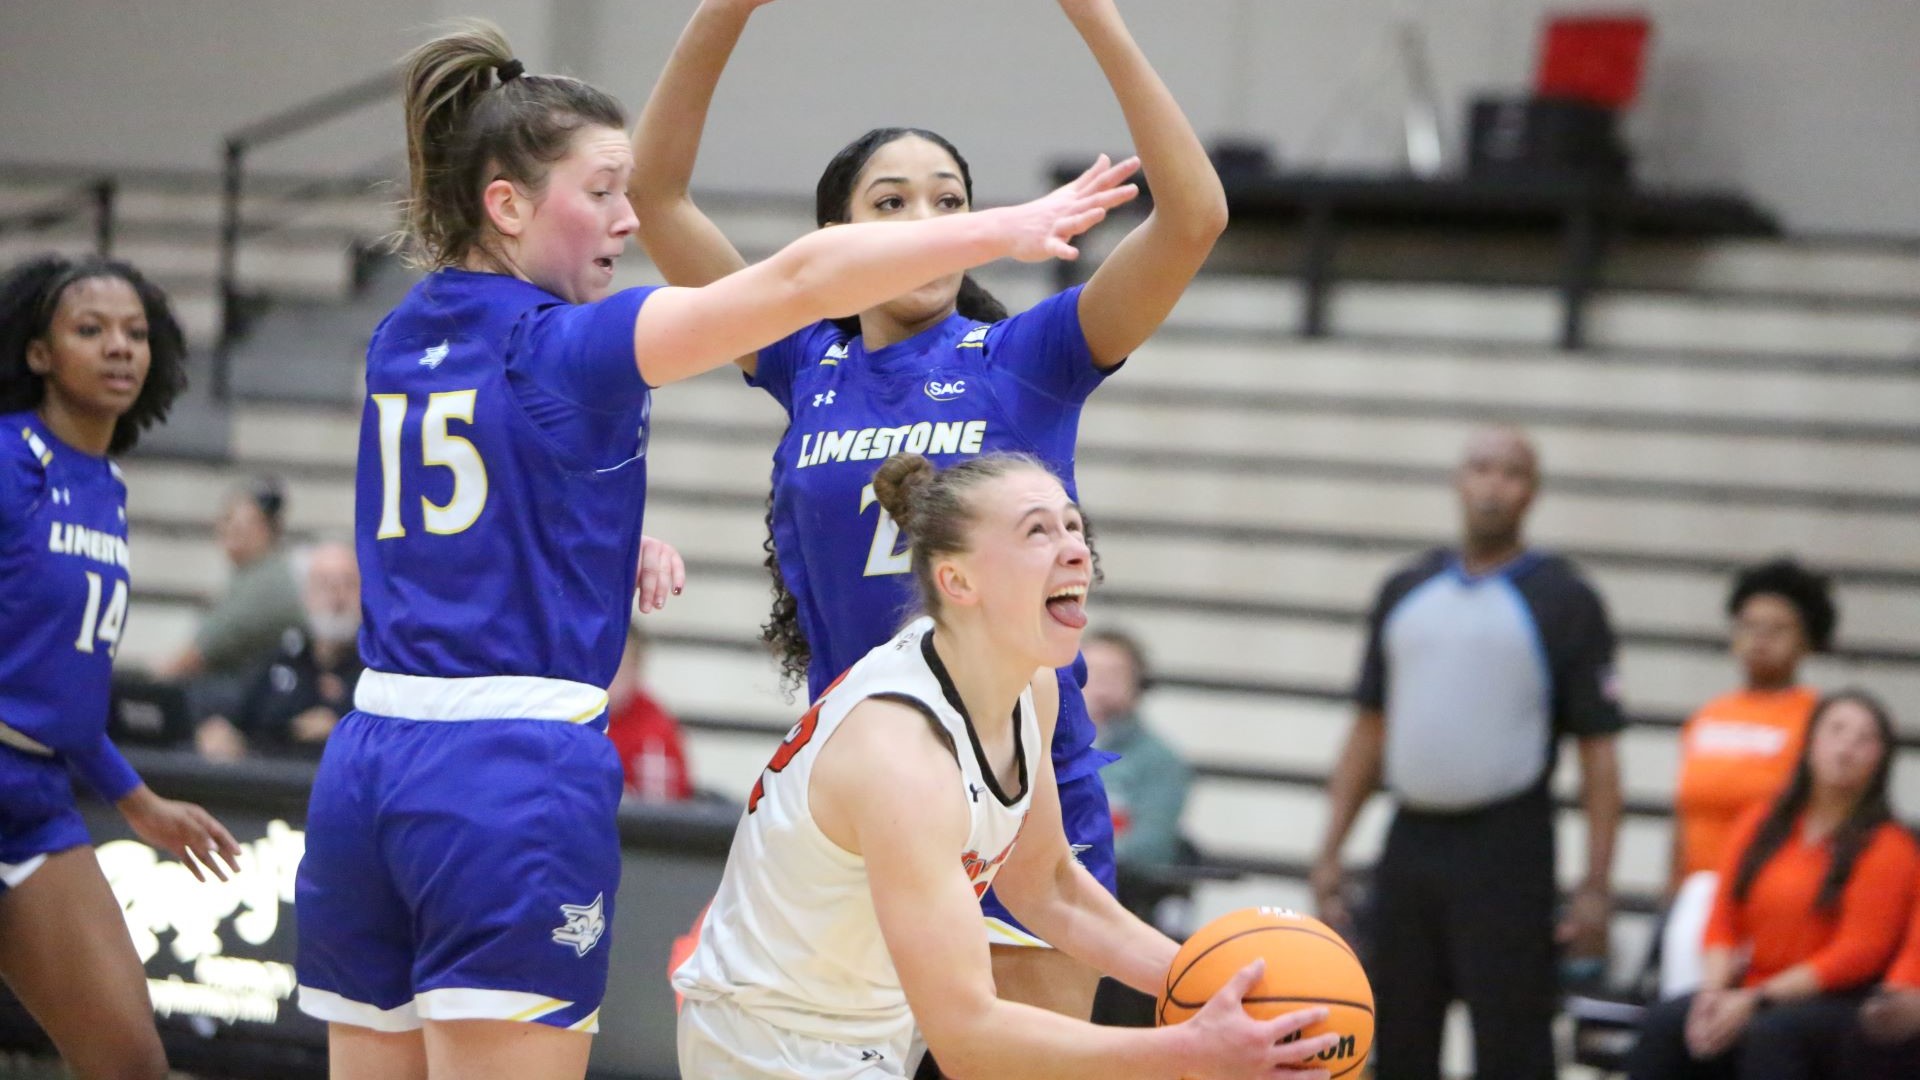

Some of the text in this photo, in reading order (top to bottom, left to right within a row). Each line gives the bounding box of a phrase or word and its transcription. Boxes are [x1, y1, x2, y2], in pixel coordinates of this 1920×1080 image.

[929, 380, 966, 396] SAC
[371, 389, 488, 540] 15
[796, 420, 987, 469] LIMESTONE
[74, 569, 128, 659] 14
